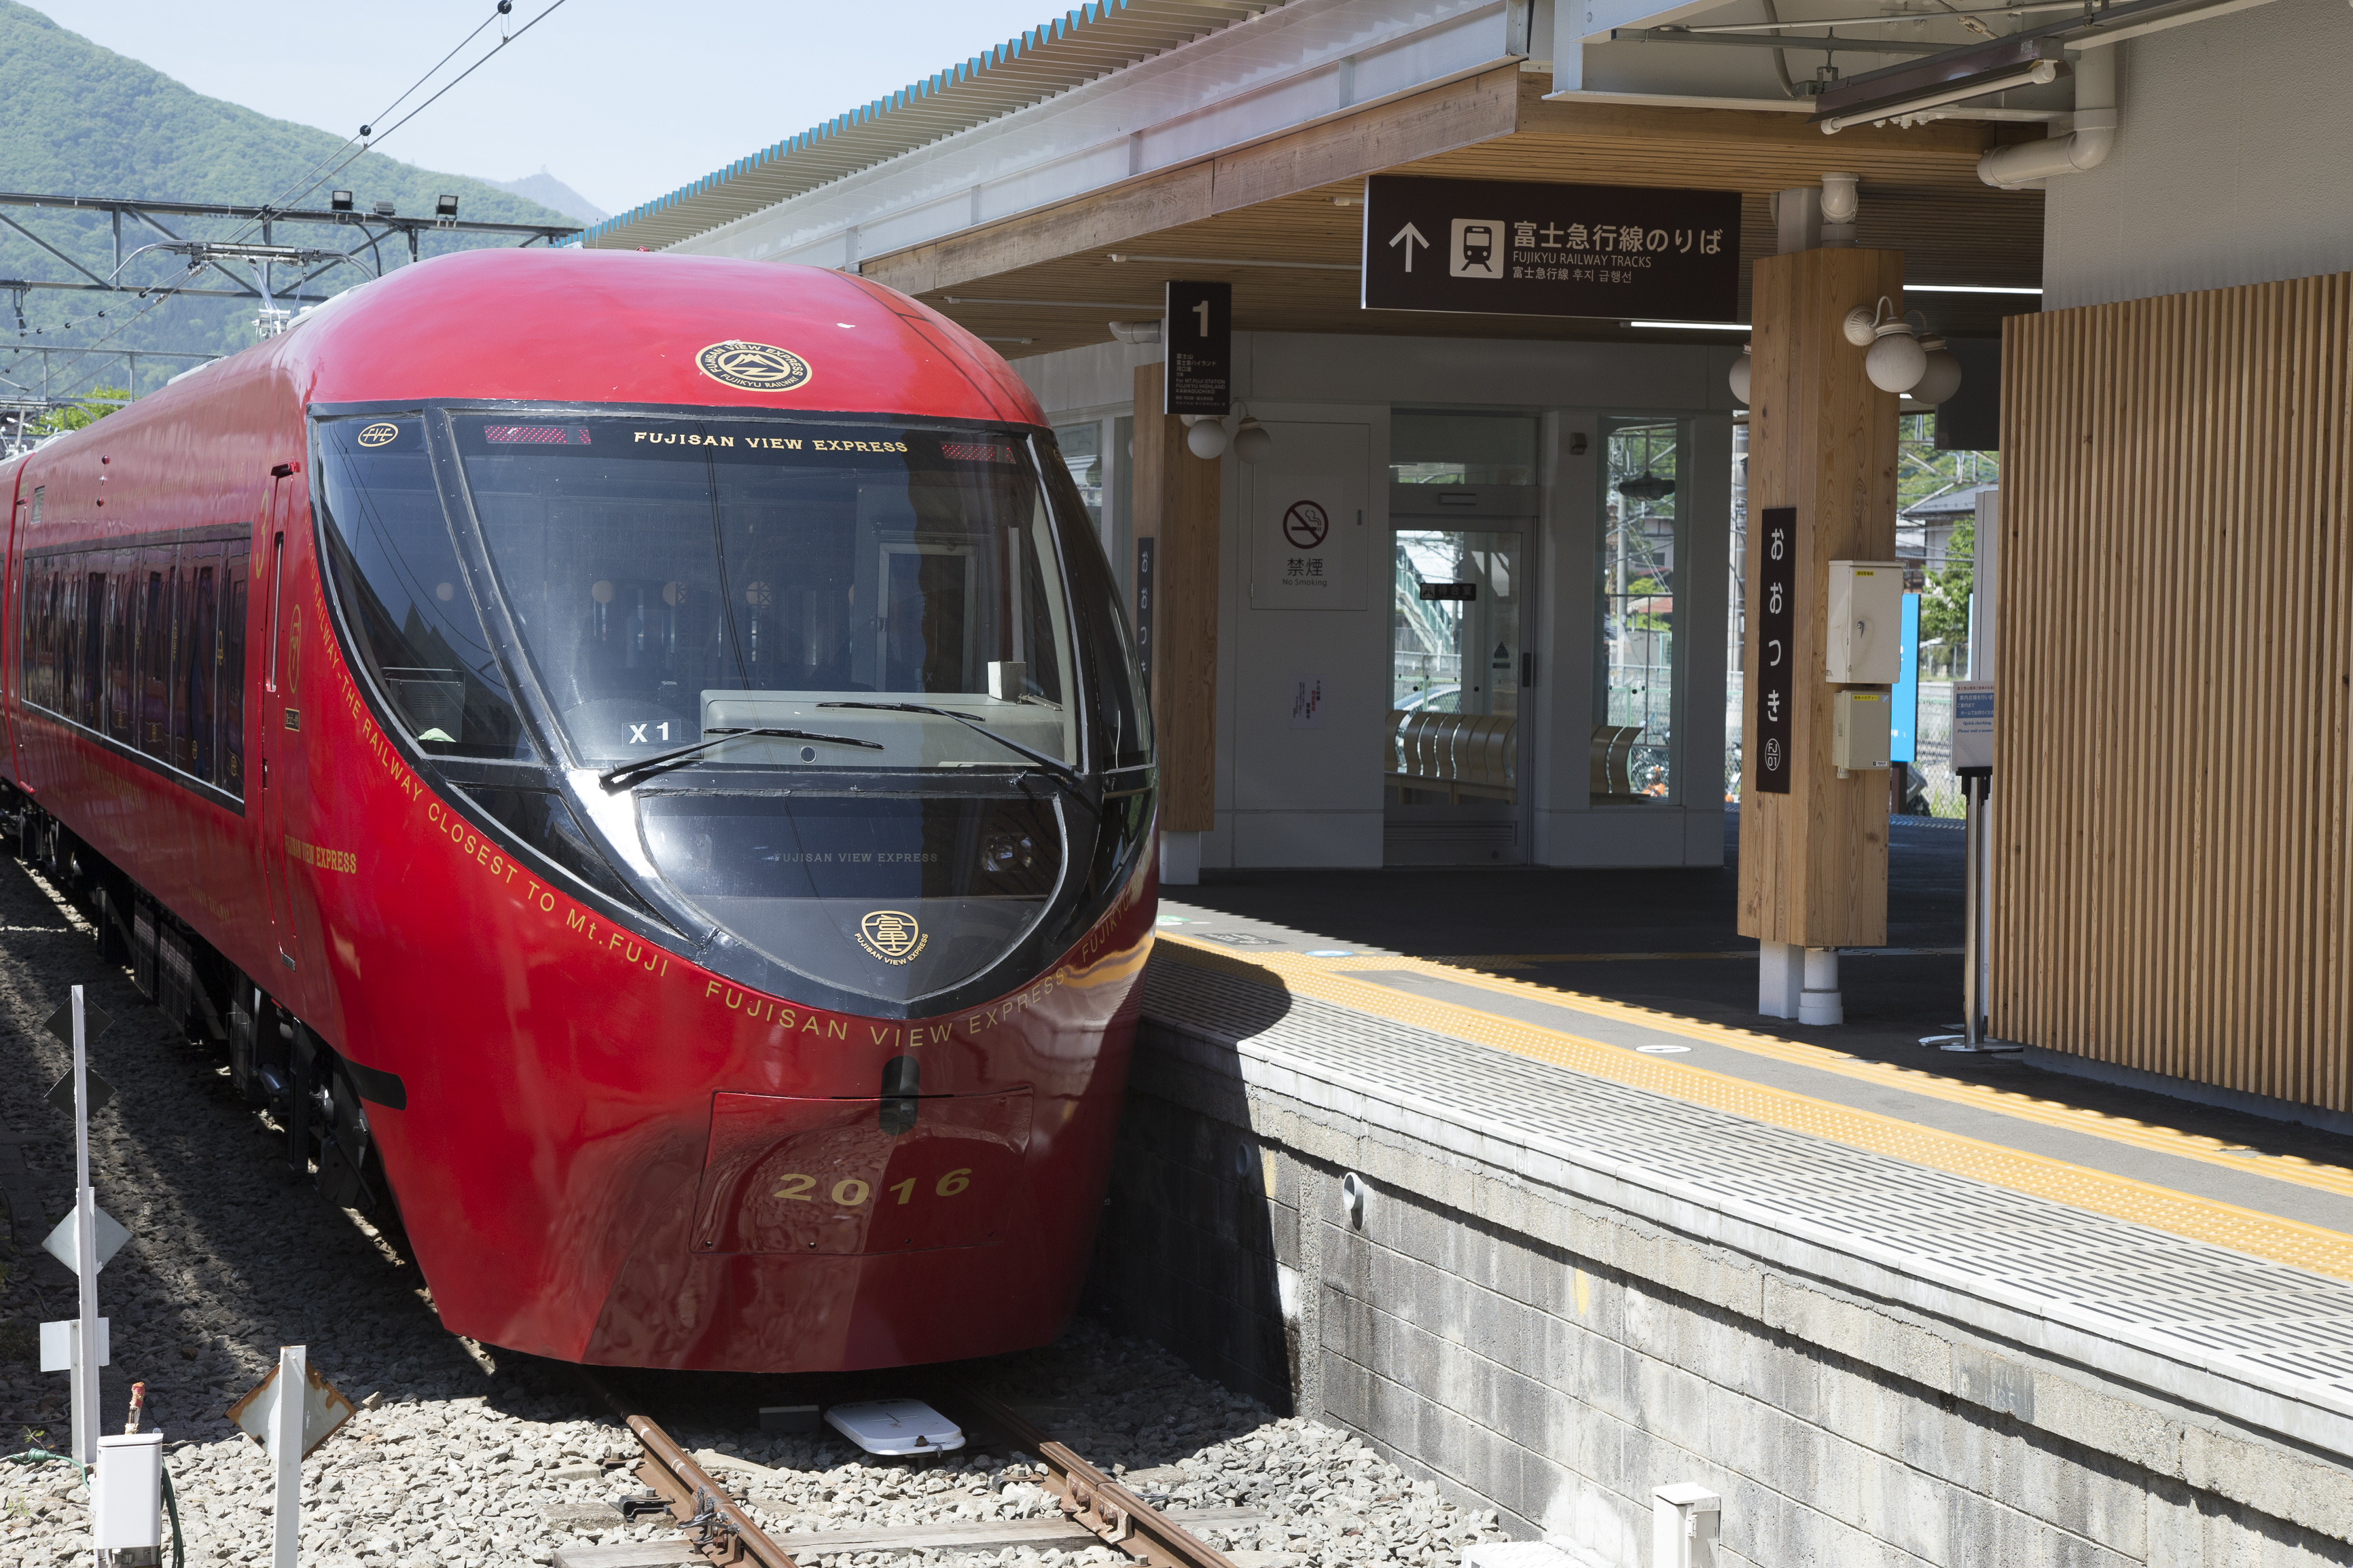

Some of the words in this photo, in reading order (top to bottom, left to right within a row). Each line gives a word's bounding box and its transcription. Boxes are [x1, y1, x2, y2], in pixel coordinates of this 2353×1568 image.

[1513, 221, 1723, 255] 富士急行線のりば
[1513, 251, 1556, 263] FUJIKYU
[1560, 252, 1608, 266] RAILWAY
[1611, 254, 1652, 268] TRACKS
[1513, 266, 1569, 280] 富士急行線
[1573, 268, 1594, 282] 후지
[1598, 269, 1632, 283] 급행선
[1192, 300, 1208, 337] 1
[765, 348, 804, 376] EXPRESS
[720, 373, 761, 388] FUJIKYU
[764, 376, 800, 388] RAILWAY
[633, 431, 735, 448] FUJISAN
[744, 437, 803, 451] VIEW
[812, 439, 909, 454] EXPRESS
[255, 488, 269, 579] 3
[1287, 558, 1324, 577] 禁煙
[1282, 578, 1293, 586] No
[1295, 578, 1327, 587] Smoking
[1439, 585, 1472, 596] 待合室
[1767, 527, 1784, 722] おおつき
[628, 723, 649, 744] X
[656, 721, 670, 741] 1
[1768, 743, 1778, 753] FJ
[1767, 756, 1777, 767] 01
[314, 581, 340, 669] RAILWAY
[362, 717, 423, 803] RAILWAY
[427, 802, 518, 885] CLOSEST
[526, 879, 556, 913] TO
[565, 907, 669, 977] Mt.FUJI
[315, 846, 357, 875] EXPRESS
[775, 853, 833, 863] FUJISAN
[838, 853, 872, 862] VIEW
[877, 853, 938, 863] EXPRESS
[854, 932, 883, 961] FUJISAN
[884, 957, 908, 966] VIEW
[907, 933, 929, 962] EXPRESS
[705, 979, 848, 1040] FUJISAN
[870, 1021, 953, 1047] VIEW
[969, 966, 1065, 1035] EXPRESS
[1081, 893, 1130, 964] FUJIKYU
[773, 1168, 973, 1206] 2016
